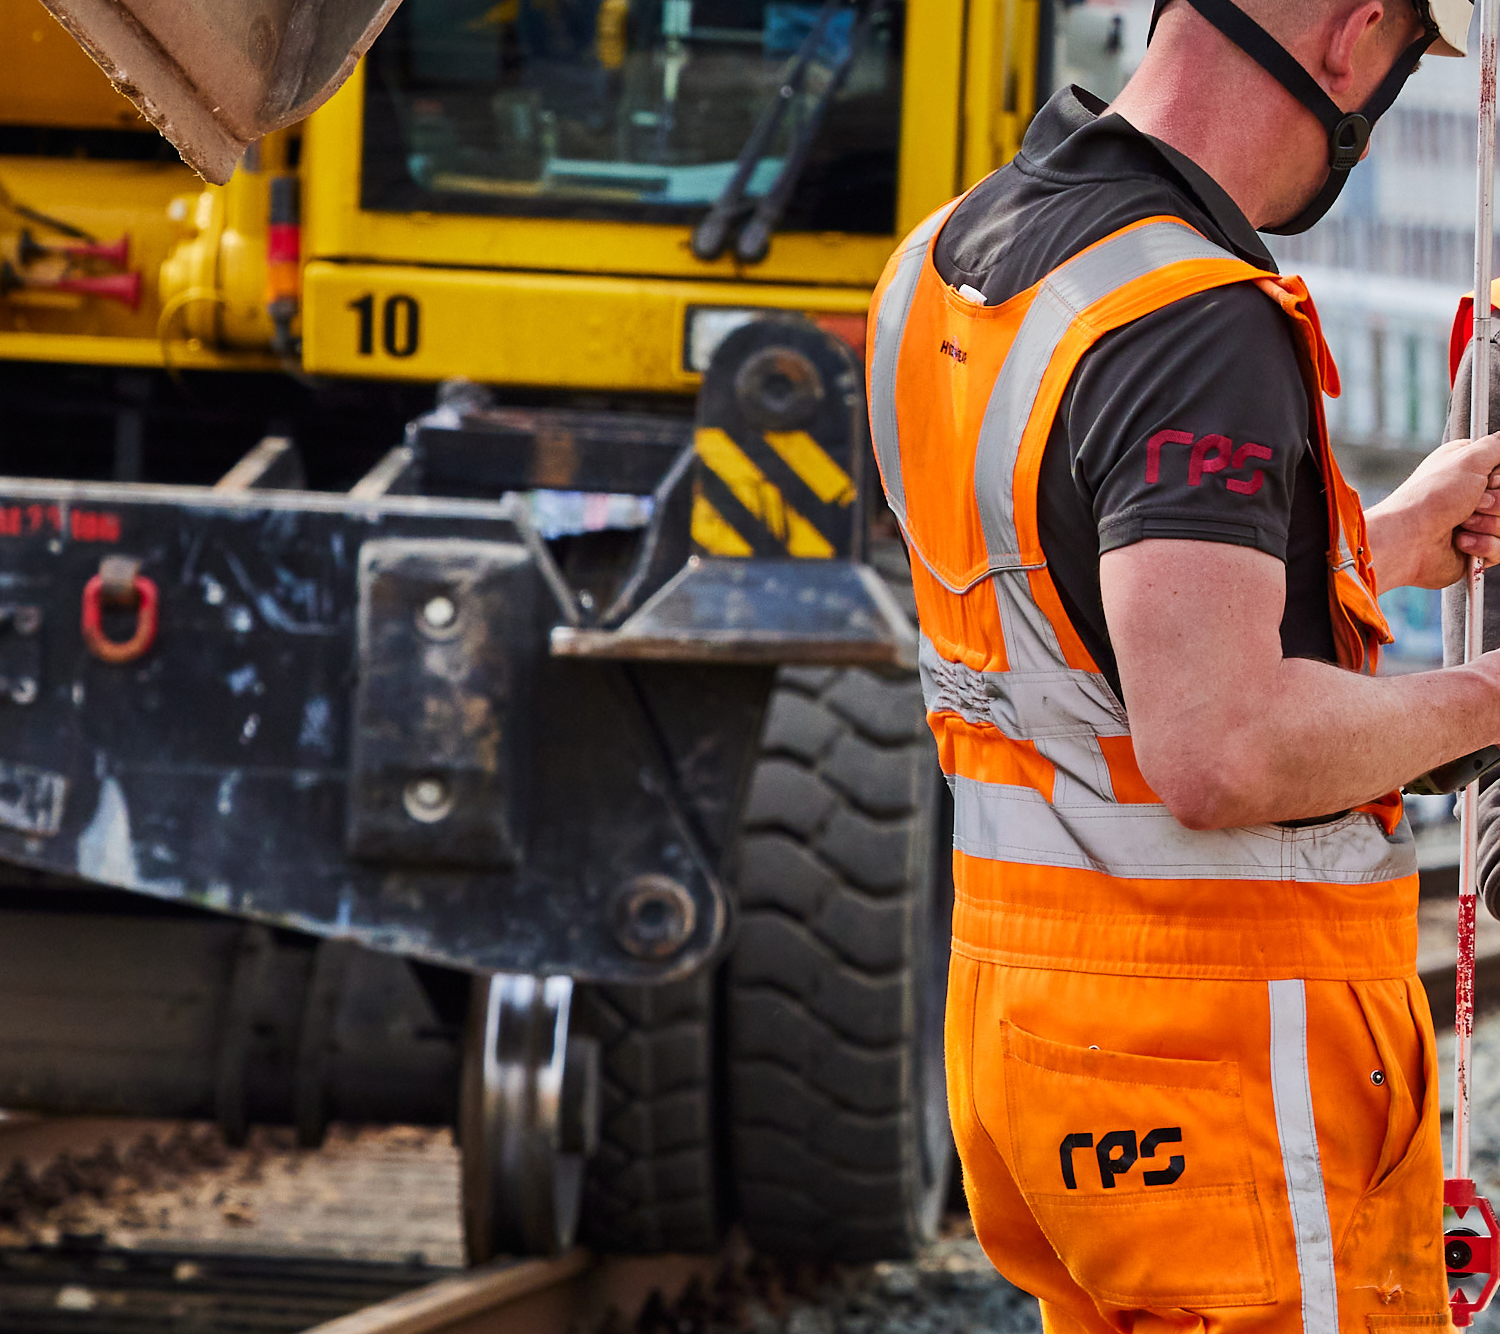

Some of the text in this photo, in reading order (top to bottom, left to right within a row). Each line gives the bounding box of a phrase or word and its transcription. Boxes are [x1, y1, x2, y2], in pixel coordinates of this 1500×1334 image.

[347, 292, 420, 358] 10
[1145, 429, 1273, 495] rps
[1060, 1127, 1185, 1189] rps
